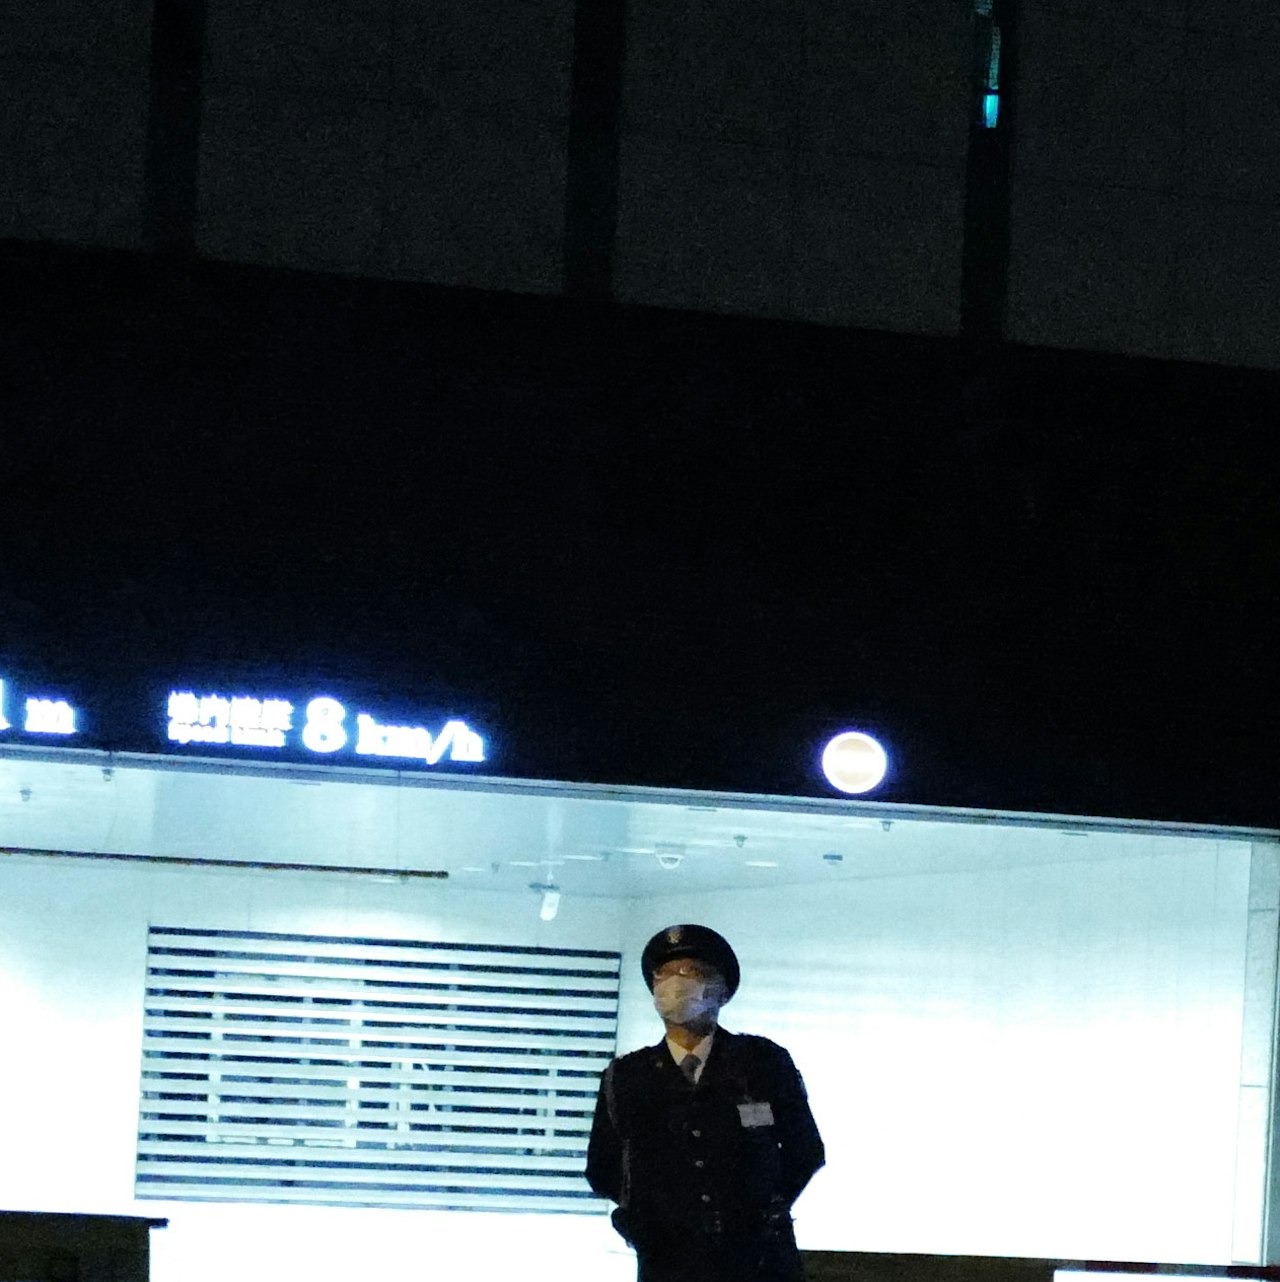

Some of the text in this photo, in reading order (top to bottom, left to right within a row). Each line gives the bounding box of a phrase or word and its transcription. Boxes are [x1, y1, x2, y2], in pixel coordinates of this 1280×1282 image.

[24, 697, 76, 734] m
[302, 696, 348, 753] 8
[356, 712, 486, 765] km/h
